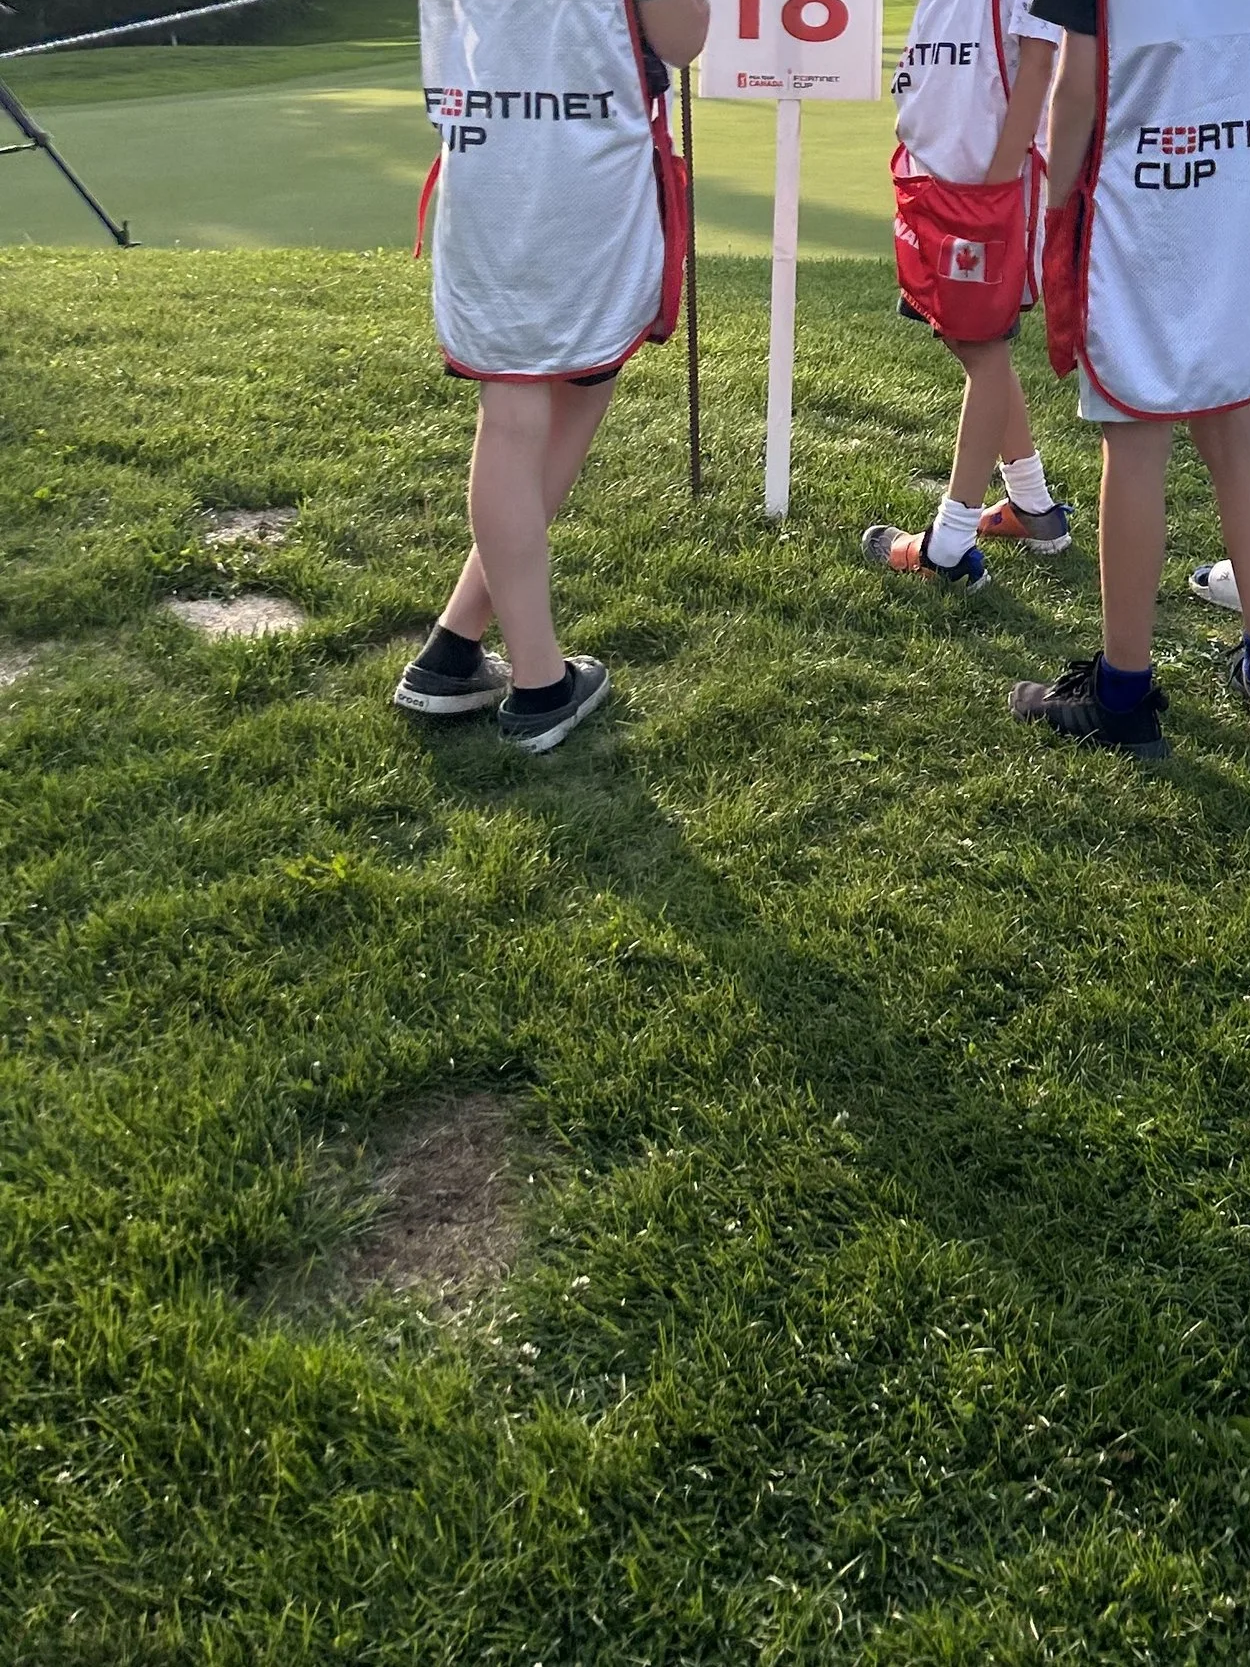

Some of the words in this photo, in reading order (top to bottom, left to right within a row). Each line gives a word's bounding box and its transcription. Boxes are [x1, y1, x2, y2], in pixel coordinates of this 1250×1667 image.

[749, 80, 785, 88] CANADA
[793, 75, 840, 83] FORTINET
[423, 87, 614, 122] FORTINET
[1134, 158, 1217, 190] CUP
